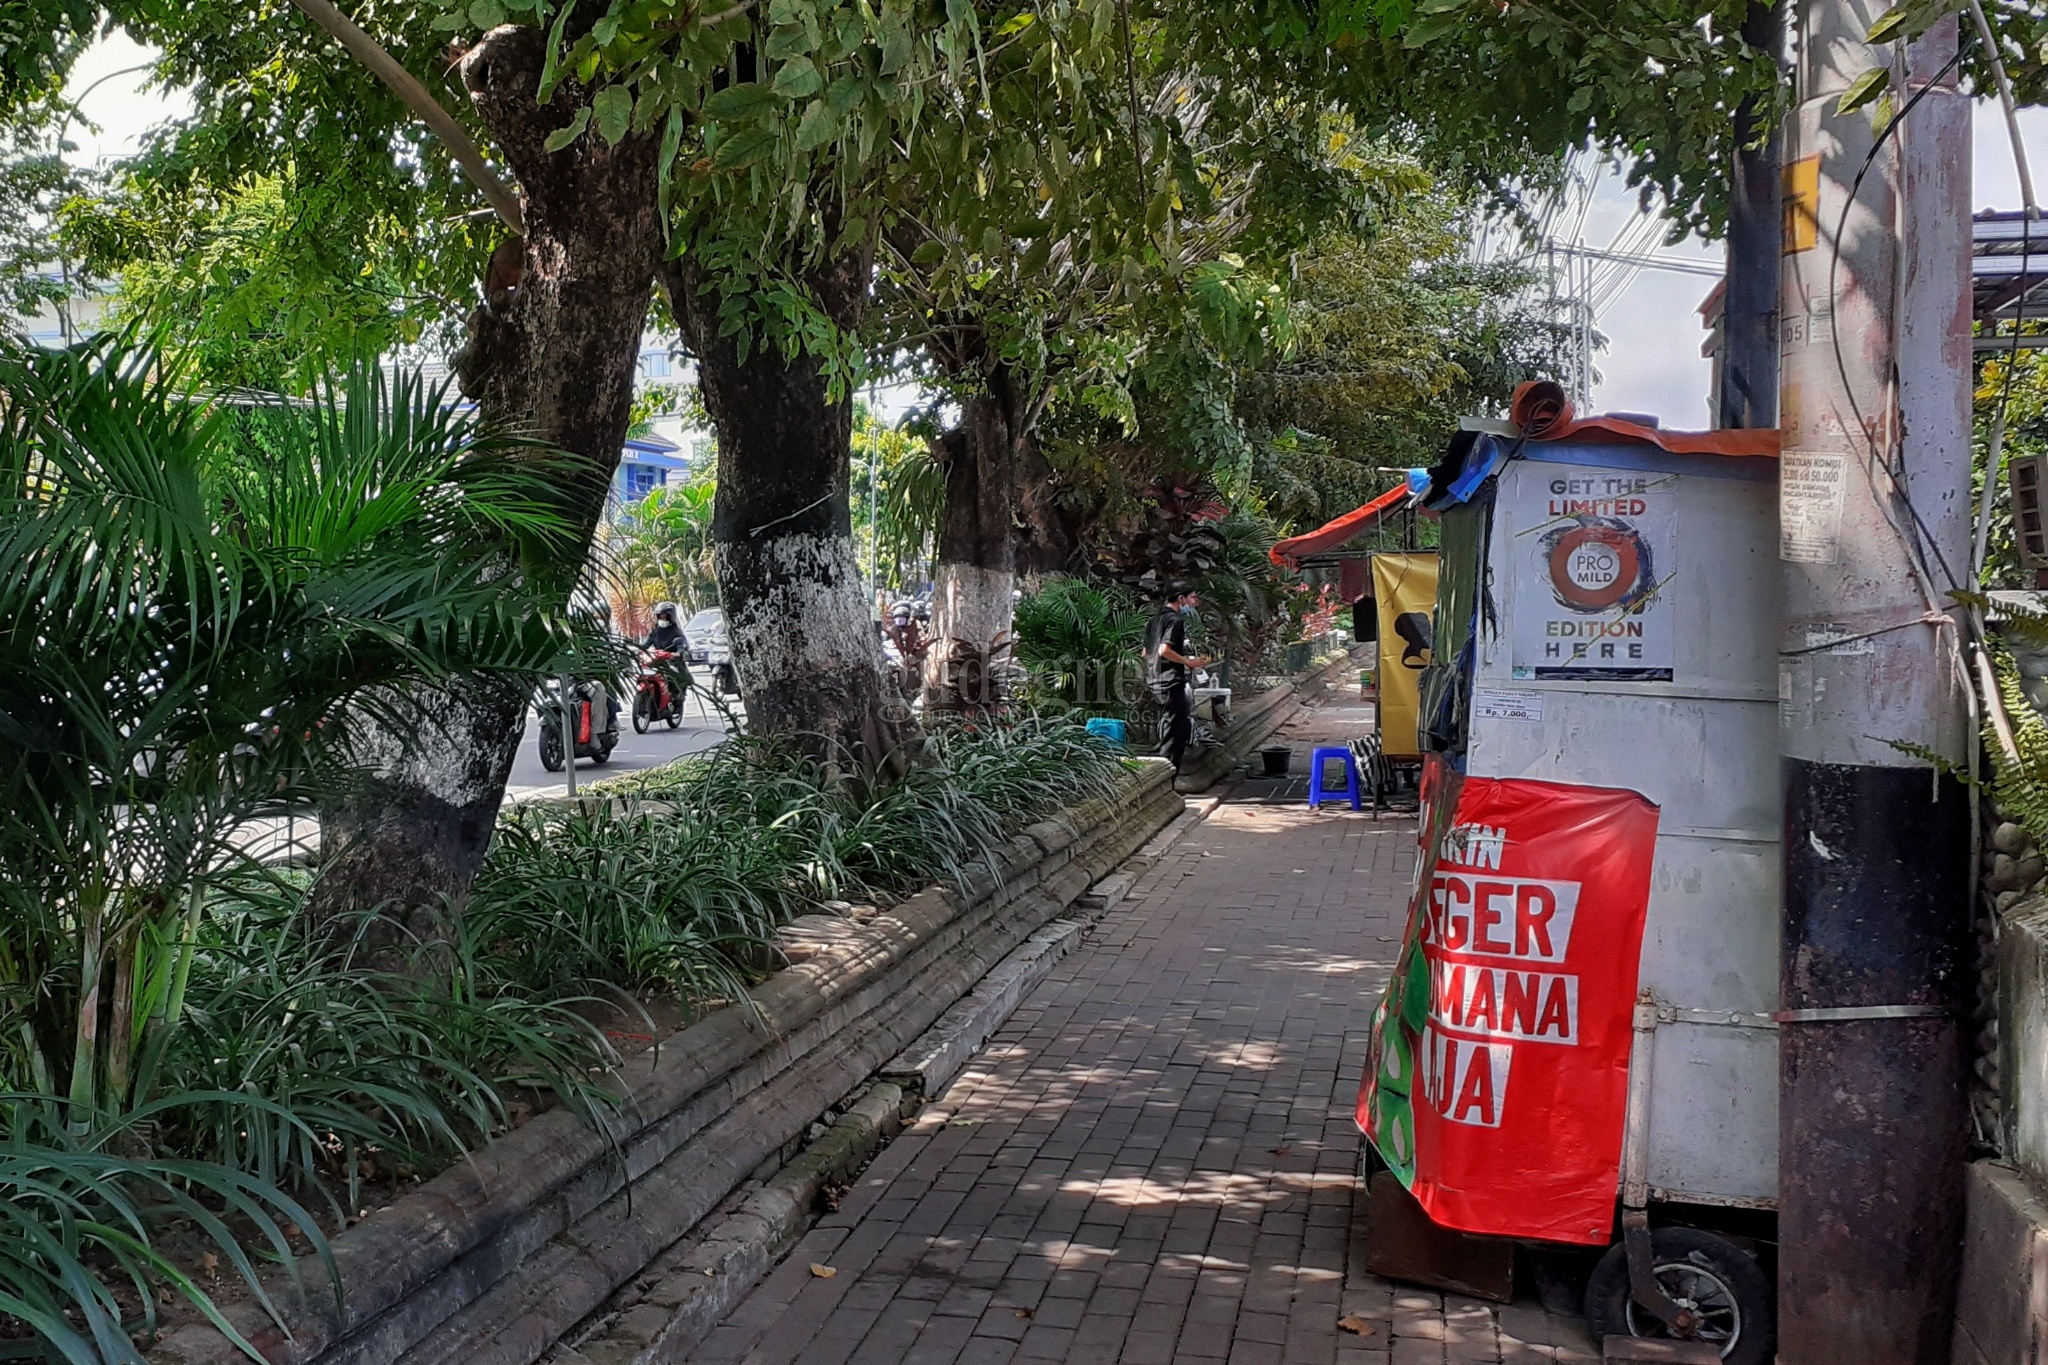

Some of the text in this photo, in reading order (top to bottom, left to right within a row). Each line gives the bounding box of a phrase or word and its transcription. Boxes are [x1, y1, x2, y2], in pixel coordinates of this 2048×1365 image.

[1811, 470, 1839, 482] 50.000
[1549, 479, 1647, 495] GET THE
[1549, 499, 1647, 516] LIMITED
[1577, 555, 1613, 571] PRO
[1577, 573, 1613, 583] MILD
[1547, 621, 1643, 637] EDITION
[1546, 643, 1643, 659] HERE
[1485, 708, 1533, 720] Rp. 7.000,-
